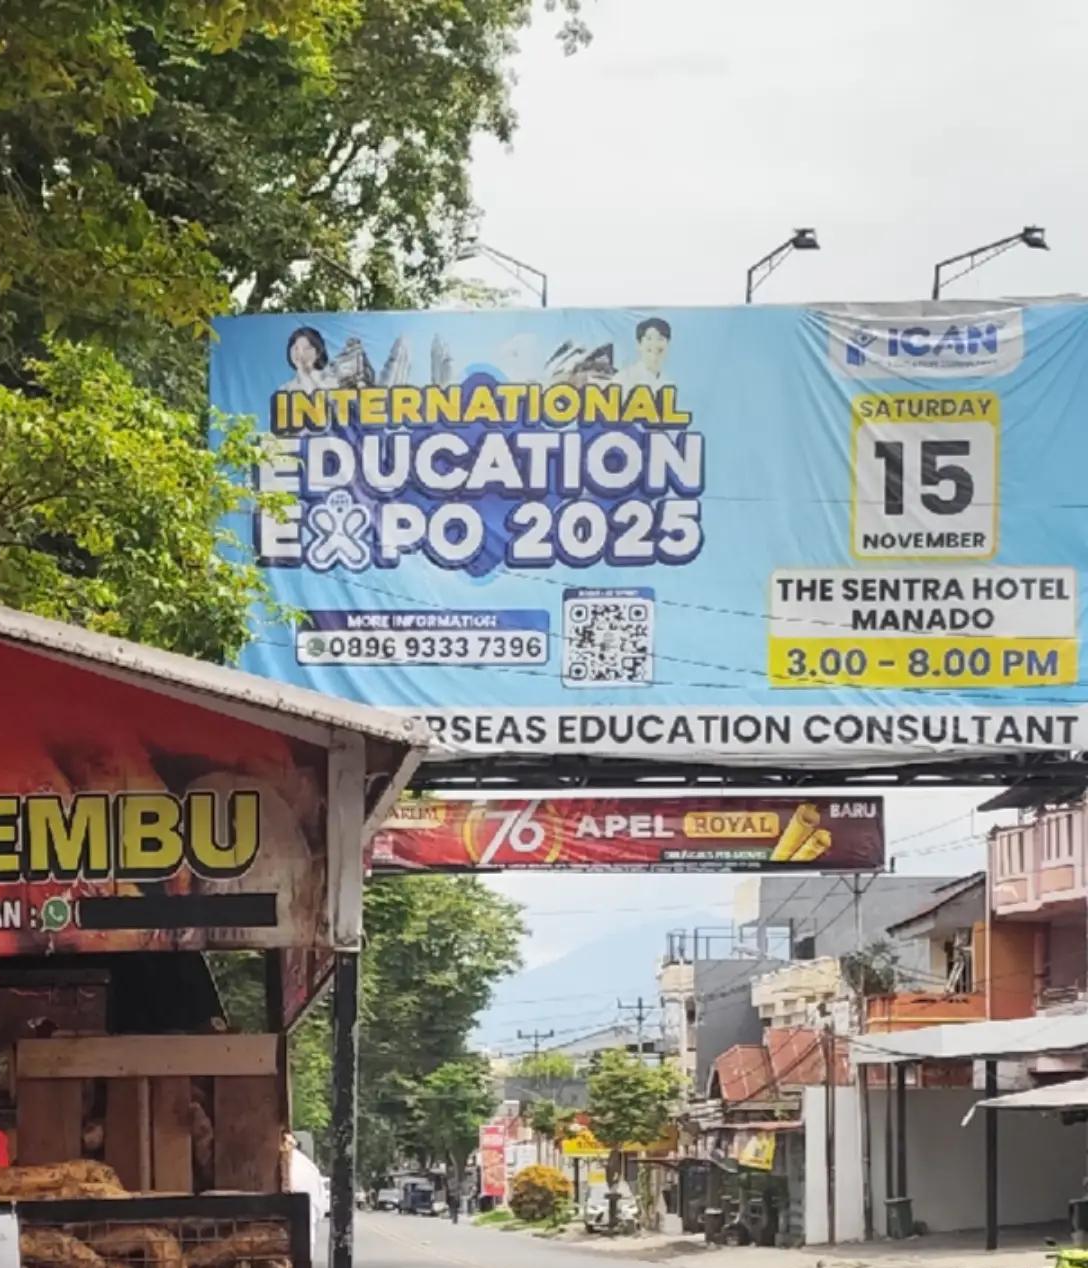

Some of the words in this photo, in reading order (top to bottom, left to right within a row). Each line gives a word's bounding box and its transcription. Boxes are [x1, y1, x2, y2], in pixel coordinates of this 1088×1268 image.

[888, 324, 998, 357] ICAN
[272, 385, 691, 432] INTERNATIONAL
[859, 399, 992, 418] SATURDAY
[258, 431, 703, 491] EDUCATION
[874, 440, 975, 516] 15
[260, 492, 484, 570] EXPO
[512, 500, 700, 560] 2025
[862, 532, 986, 550] NOVEMBER
[777, 578, 833, 602] THE
[842, 577, 964, 602] SENTRA
[973, 577, 1070, 601] HOTEL
[347, 614, 393, 628] MORE
[392, 614, 497, 628] INFORMATION
[851, 608, 995, 631] MANADO
[329, 636, 396, 658] 0896
[405, 636, 469, 657] 9333
[478, 636, 543, 657] 7396
[787, 648, 867, 677] 3.00
[908, 648, 992, 676] 8.00
[1003, 648, 1058, 676] PM
[412, 714, 547, 744] RSEAS
[558, 713, 790, 745] EDUCATION
[803, 715, 1079, 745] CONSULTANT
[386, 806, 438, 820] ARUM
[829, 803, 877, 818] BARU
[480, 799, 545, 864] 76
[576, 814, 675, 838] APEL
[694, 813, 773, 834] ROYAL
